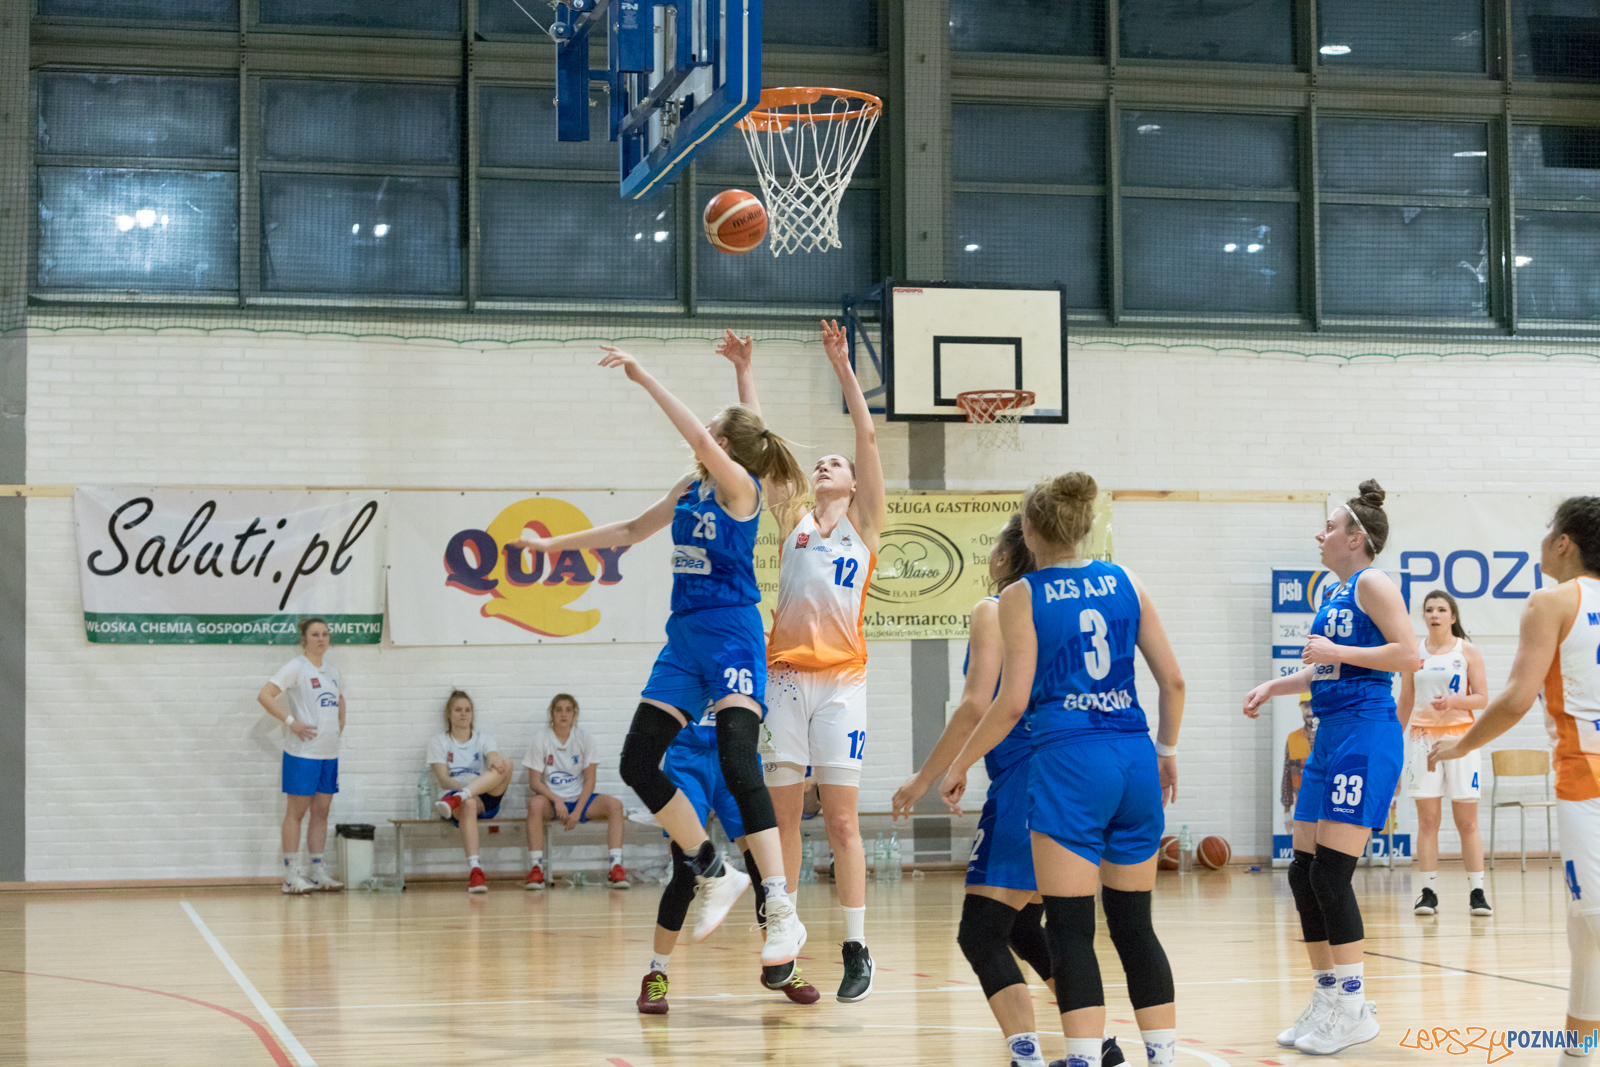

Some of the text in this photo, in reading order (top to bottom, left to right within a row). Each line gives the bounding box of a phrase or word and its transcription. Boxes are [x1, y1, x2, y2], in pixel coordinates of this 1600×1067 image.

[732, 208, 763, 228] molten
[886, 501, 1023, 514] SŁUGA GASTRONOM
[692, 512, 717, 540] 26
[755, 533, 780, 546] koli
[980, 534, 996, 546] Or
[87, 497, 378, 611] Saluti.pl
[444, 528, 632, 596] QUAY
[832, 557, 858, 588] 12
[894, 558, 940, 579] Marco
[1400, 549, 1543, 599] POZ
[892, 590, 918, 598] BAR
[1044, 575, 1117, 603] AZS AJP
[1279, 579, 1302, 605] psb
[85, 620, 381, 635] WŁOSKA CHEMIA GOSPODARCZA SMETYKI
[863, 611, 971, 628] w.barmarco.p
[1324, 608, 1354, 637] 33
[1079, 609, 1111, 680] 3
[724, 668, 753, 695] 26
[1449, 674, 1461, 693] 4
[1063, 688, 1132, 712] GORZÓW
[848, 730, 866, 760] 12
[1331, 774, 1363, 806] 33
[1471, 772, 1479, 791] 4
